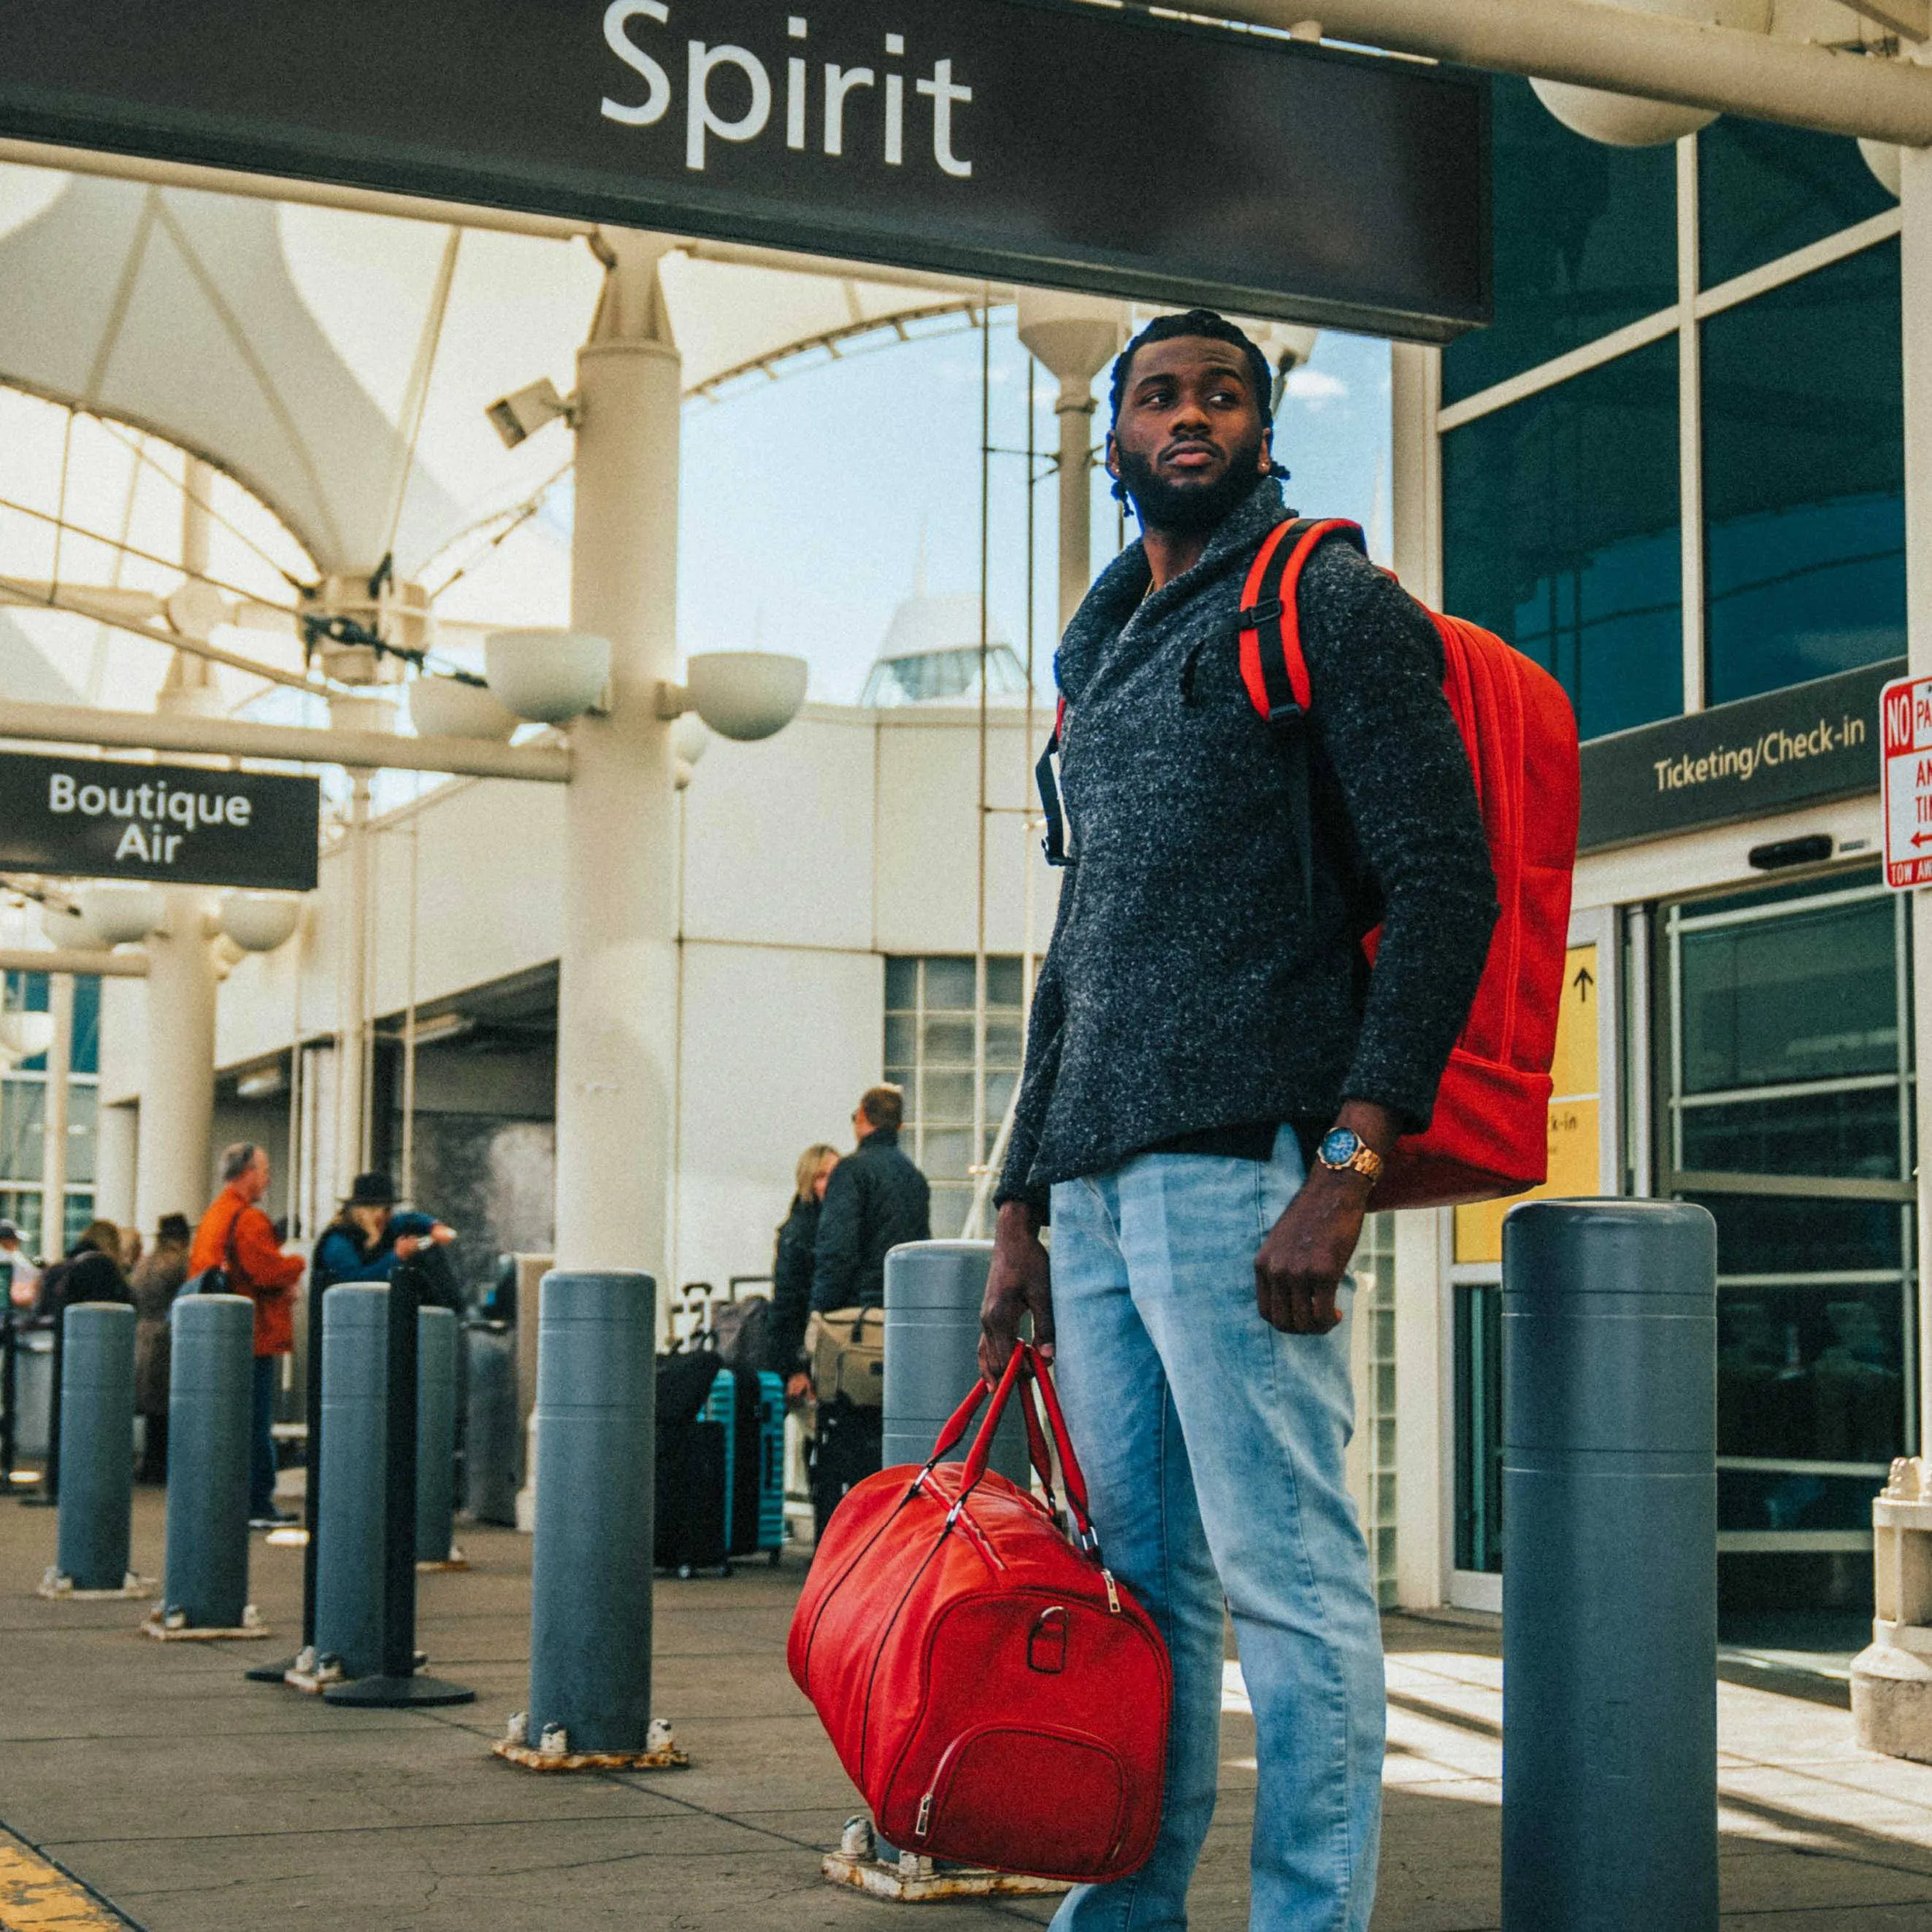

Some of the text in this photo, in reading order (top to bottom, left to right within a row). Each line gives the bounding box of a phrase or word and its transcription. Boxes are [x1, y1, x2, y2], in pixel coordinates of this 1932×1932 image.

[601, 0, 973, 177] Spirit
[1887, 694, 1910, 749] NO
[1654, 714, 1865, 793] Ticketing/Check-in
[49, 773, 252, 832] Boutique
[115, 824, 183, 864] Air
[1890, 862, 1913, 885] TOW
